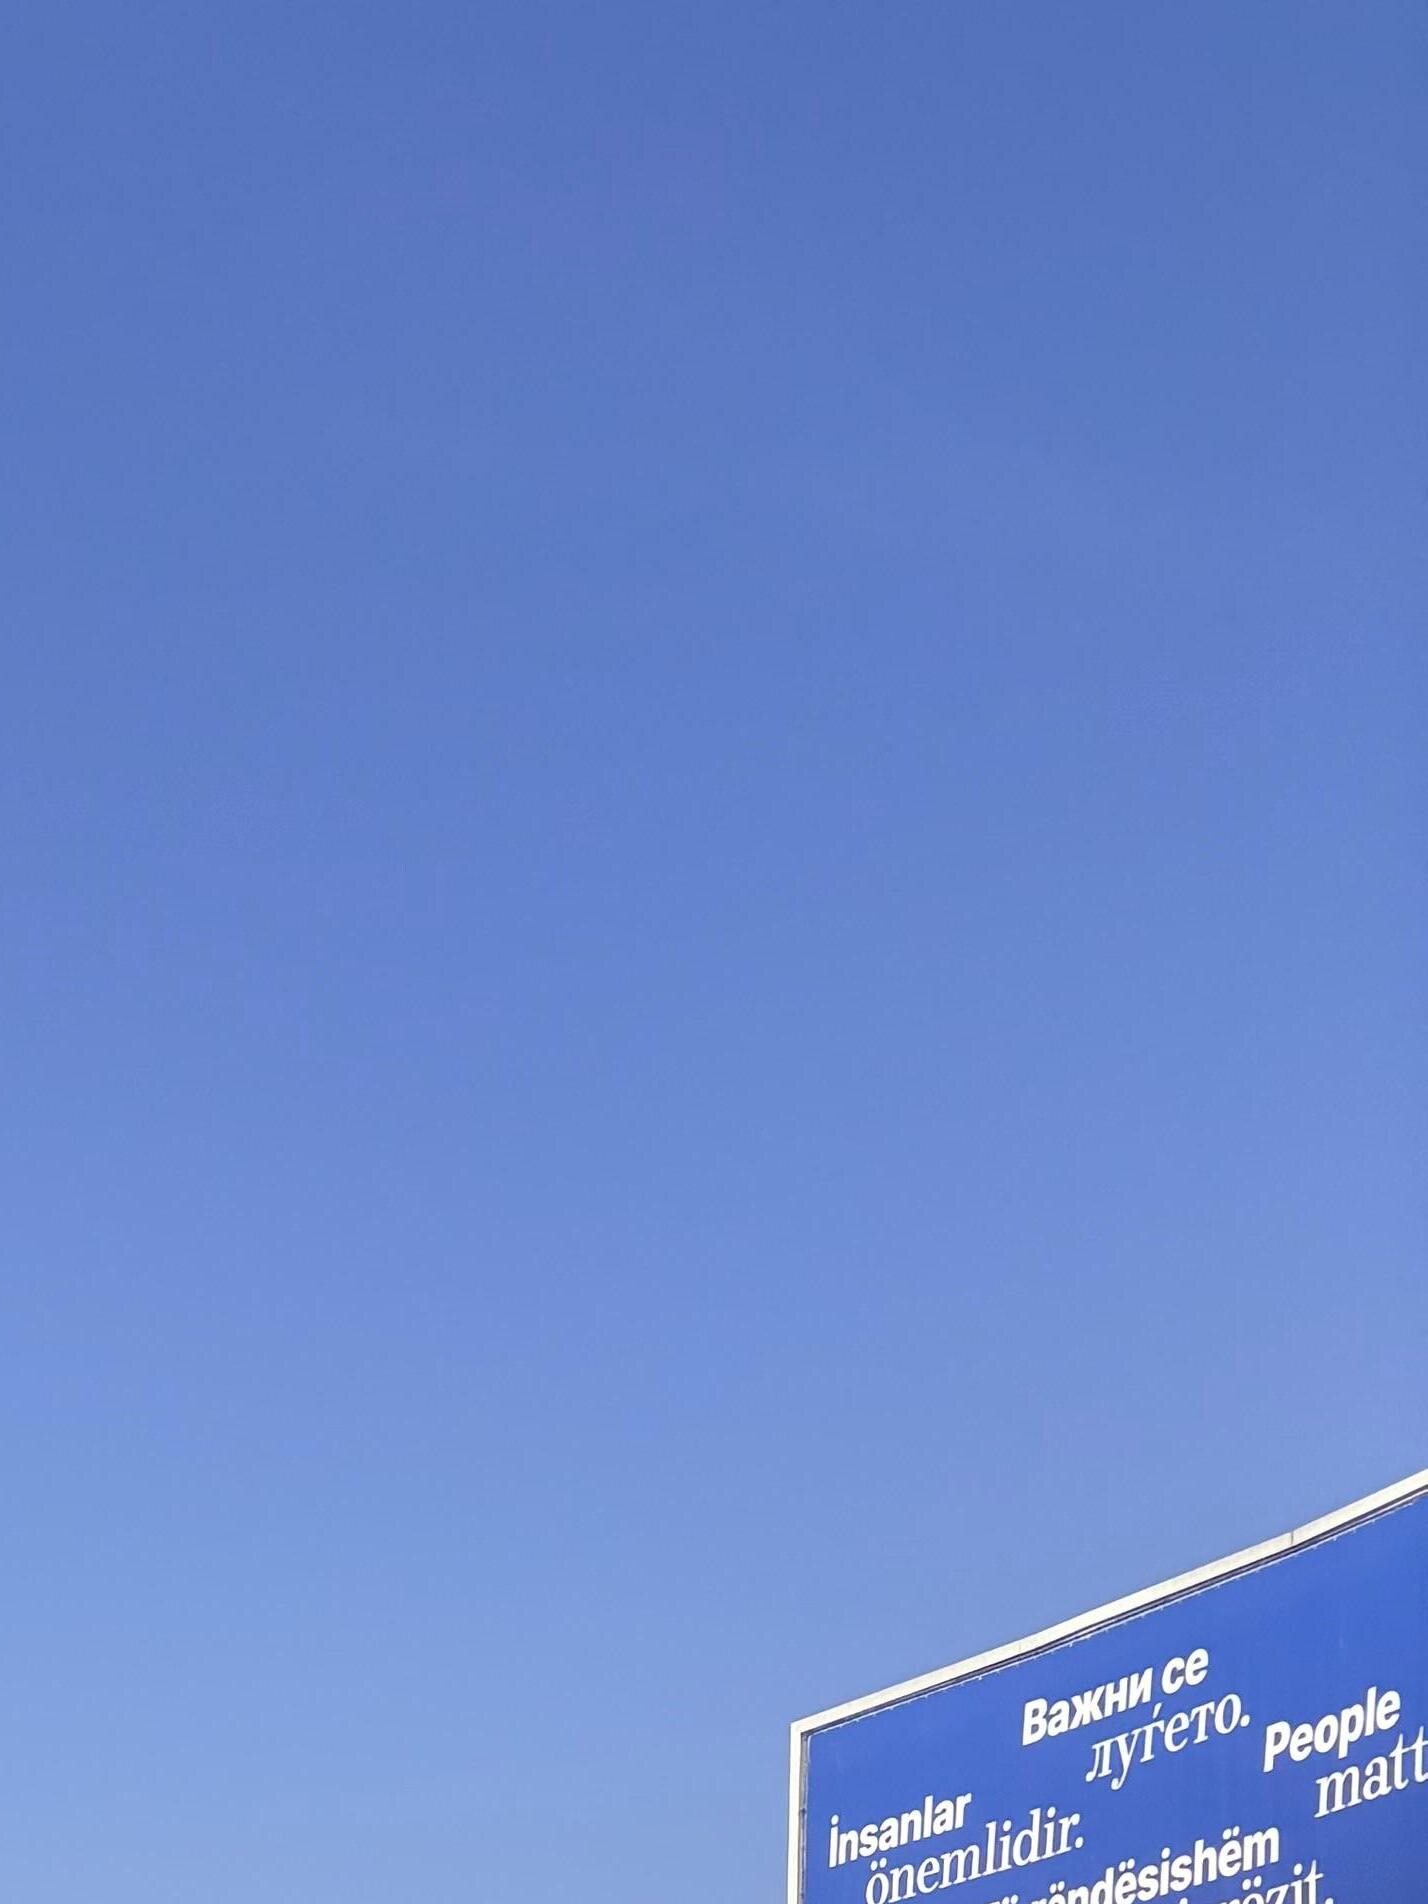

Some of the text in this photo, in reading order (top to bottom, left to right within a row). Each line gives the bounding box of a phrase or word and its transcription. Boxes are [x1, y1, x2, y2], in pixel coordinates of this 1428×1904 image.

[1022, 1648, 1209, 1746] Важни се
[1085, 1693, 1250, 1790] луѓето.
[1263, 1686, 1401, 1774] People
